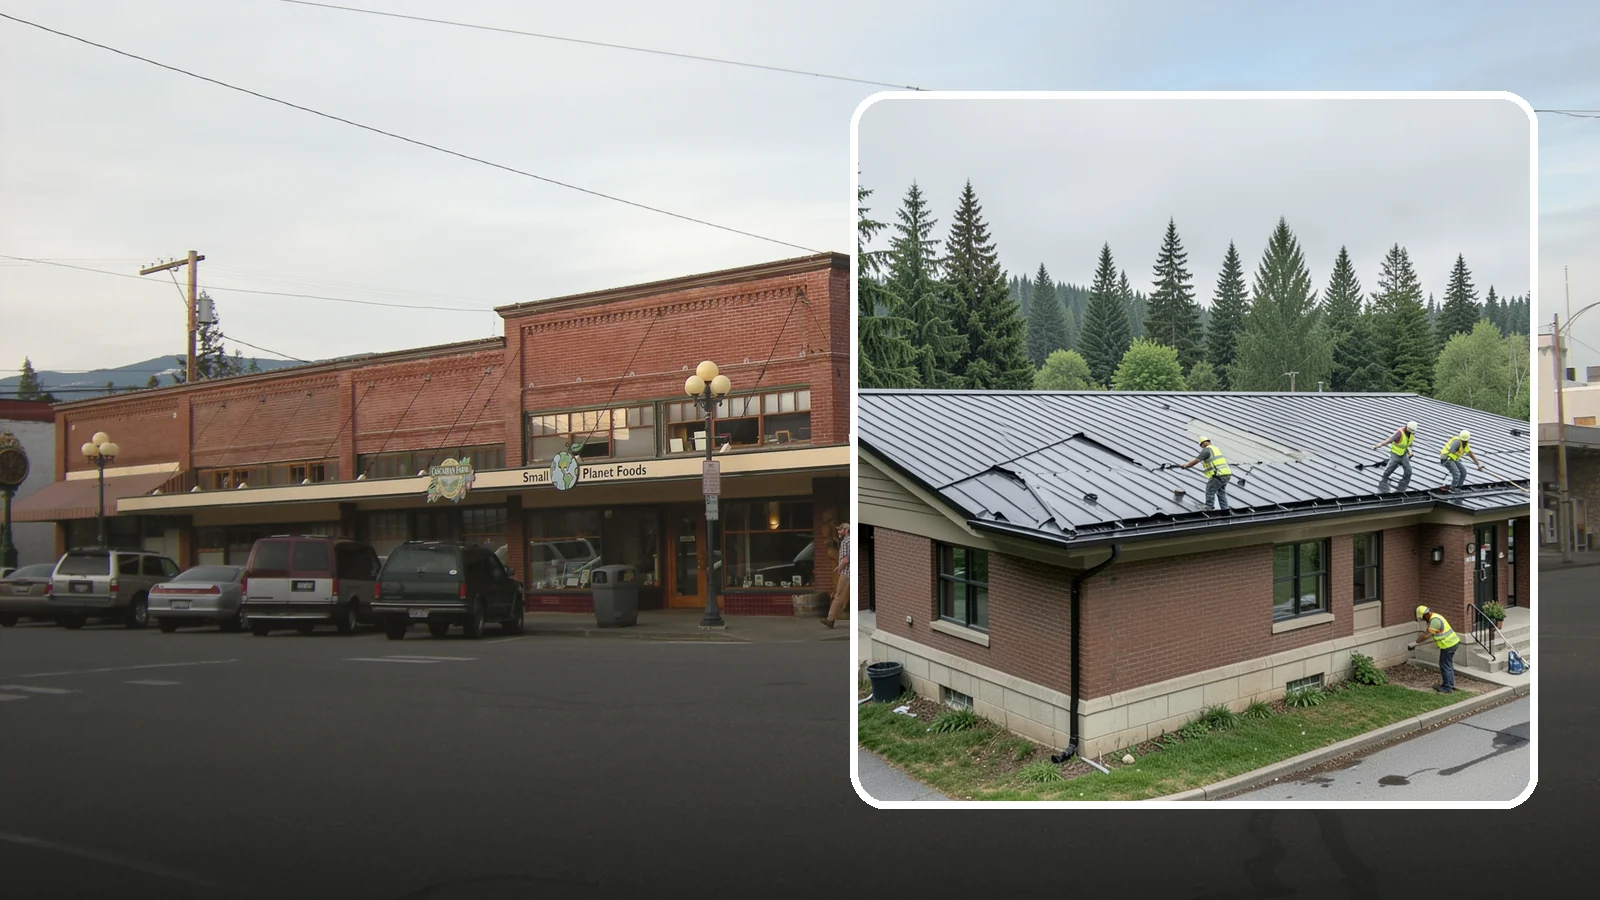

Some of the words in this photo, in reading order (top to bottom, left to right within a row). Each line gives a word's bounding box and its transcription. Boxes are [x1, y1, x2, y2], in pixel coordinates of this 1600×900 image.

[523, 470, 549, 483] Small
[583, 468, 614, 480] Planet
[617, 464, 647, 477] Foods
